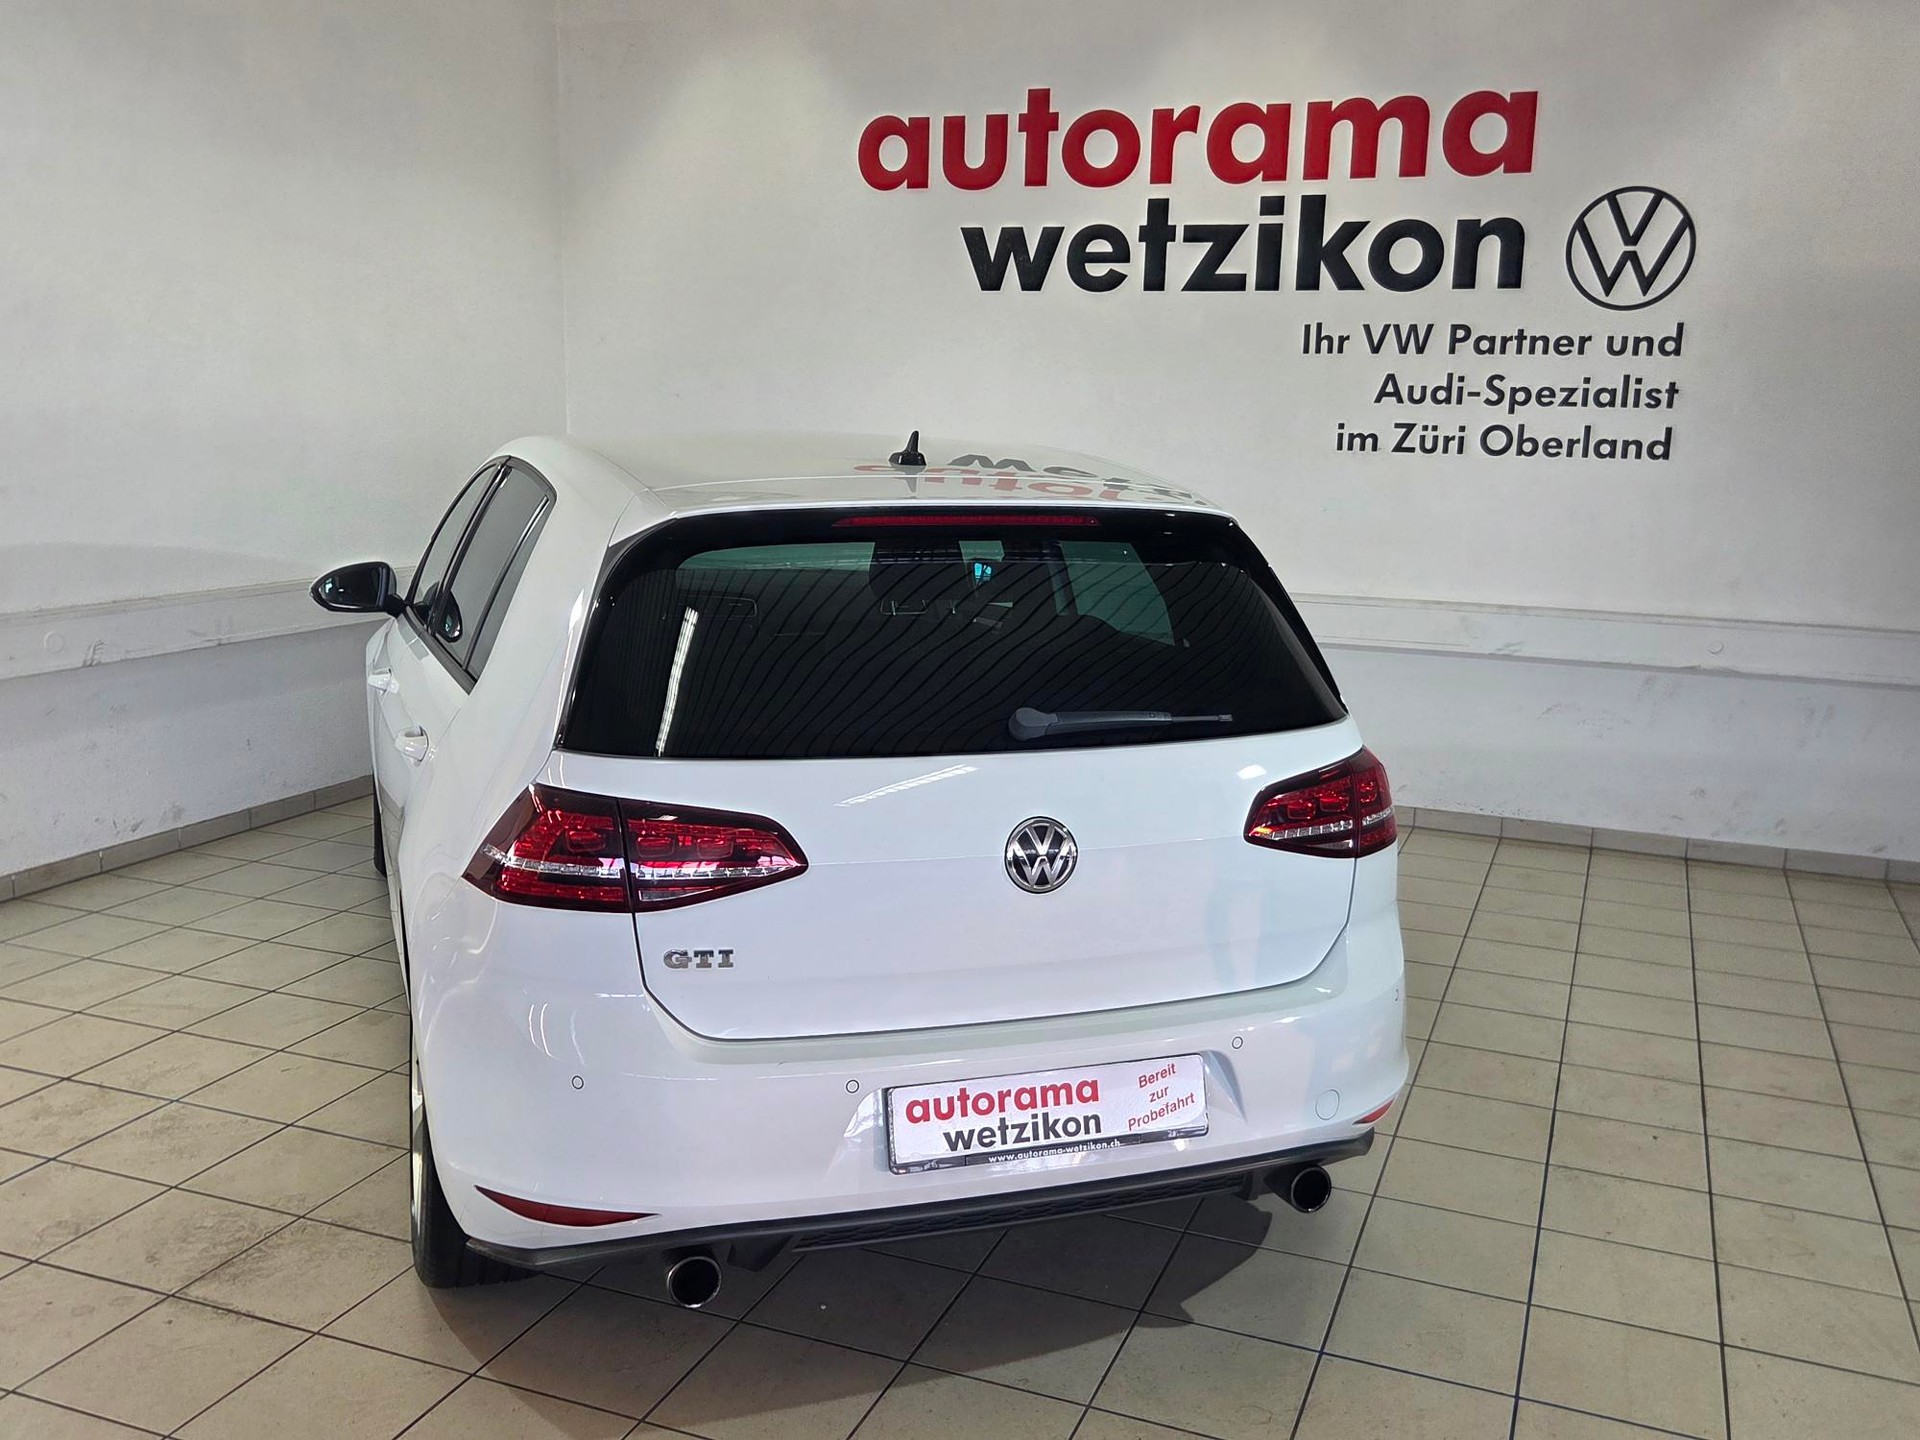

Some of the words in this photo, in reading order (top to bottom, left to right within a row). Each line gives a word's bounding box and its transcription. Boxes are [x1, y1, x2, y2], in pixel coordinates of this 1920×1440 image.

[857, 87, 1539, 191] autorama
[960, 193, 1526, 293] wetzikon
[1302, 322, 1351, 355] Ihr
[1362, 323, 1435, 355] VW
[1448, 323, 1593, 356] Partner
[1606, 321, 1685, 357] und
[1373, 372, 1680, 415] Audi-Spezialist
[1336, 422, 1379, 452] im
[1390, 422, 1466, 455] Züri
[1479, 423, 1673, 461] Oberland
[663, 949, 735, 969] GTI
[1138, 1062, 1177, 1089] Bereit
[1149, 1084, 1170, 1104] zur
[906, 1079, 1099, 1124] autorama
[1127, 1092, 1195, 1131] Probefahrt
[943, 1112, 1101, 1152] wetzikon
[988, 1138, 1121, 1163] www.autorama-wetzikon.ch
